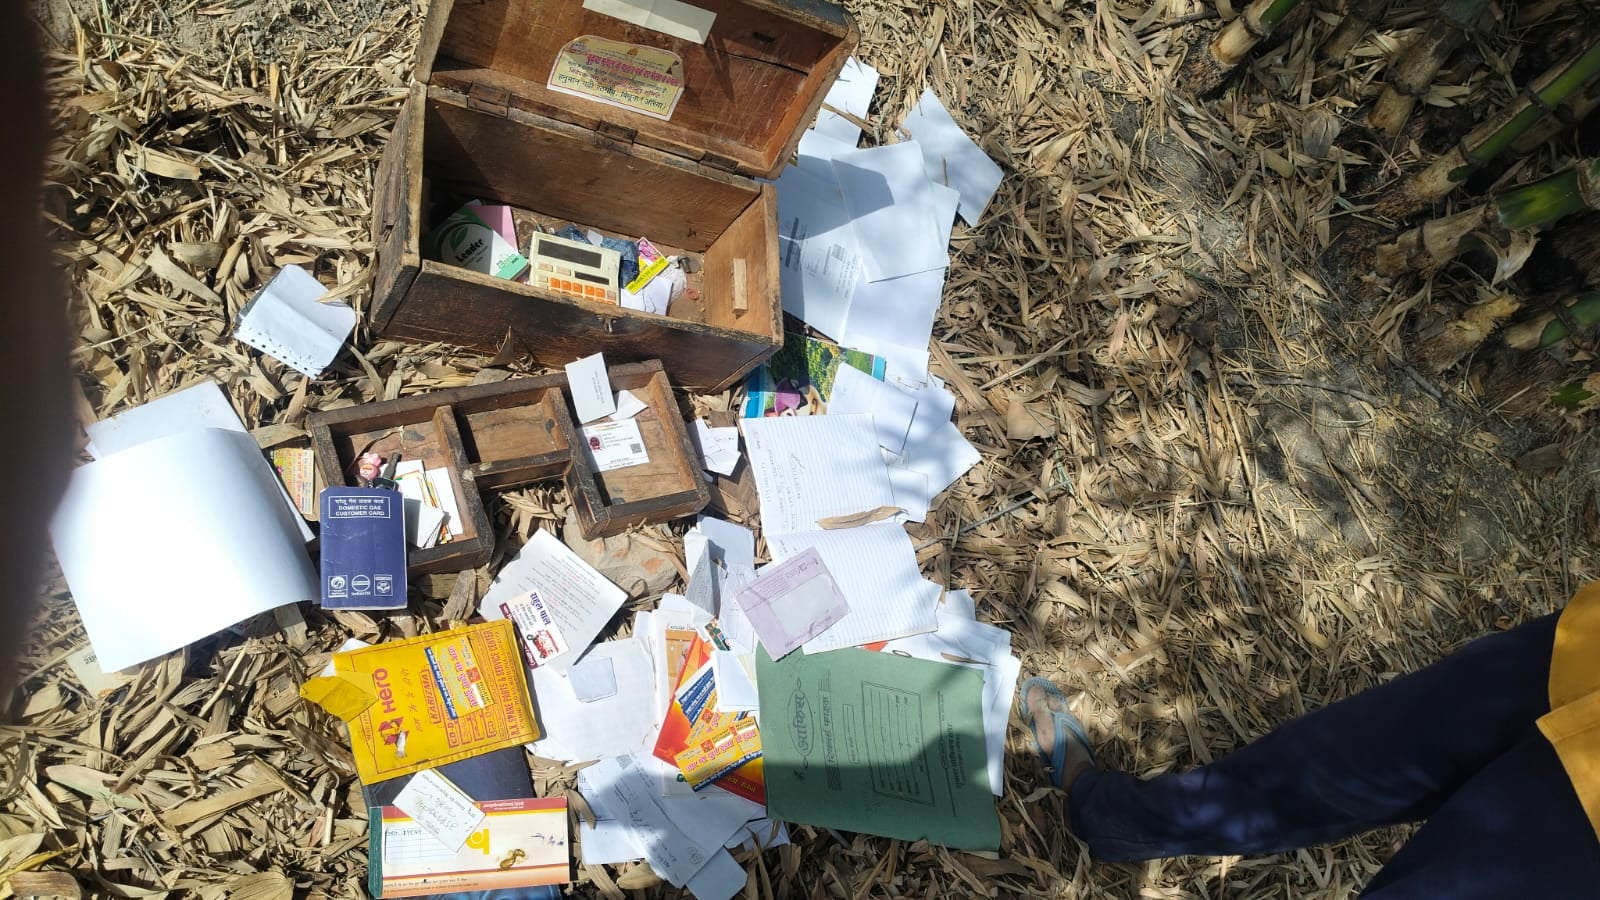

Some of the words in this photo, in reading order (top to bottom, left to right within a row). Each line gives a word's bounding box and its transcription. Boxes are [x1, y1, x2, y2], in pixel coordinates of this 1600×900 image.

[455, 237, 484, 264] Leader
[529, 592, 543, 610] राहुल
[538, 609, 552, 626] पाल
[374, 668, 397, 714] Hero
[421, 673, 439, 723] KARIZMA
